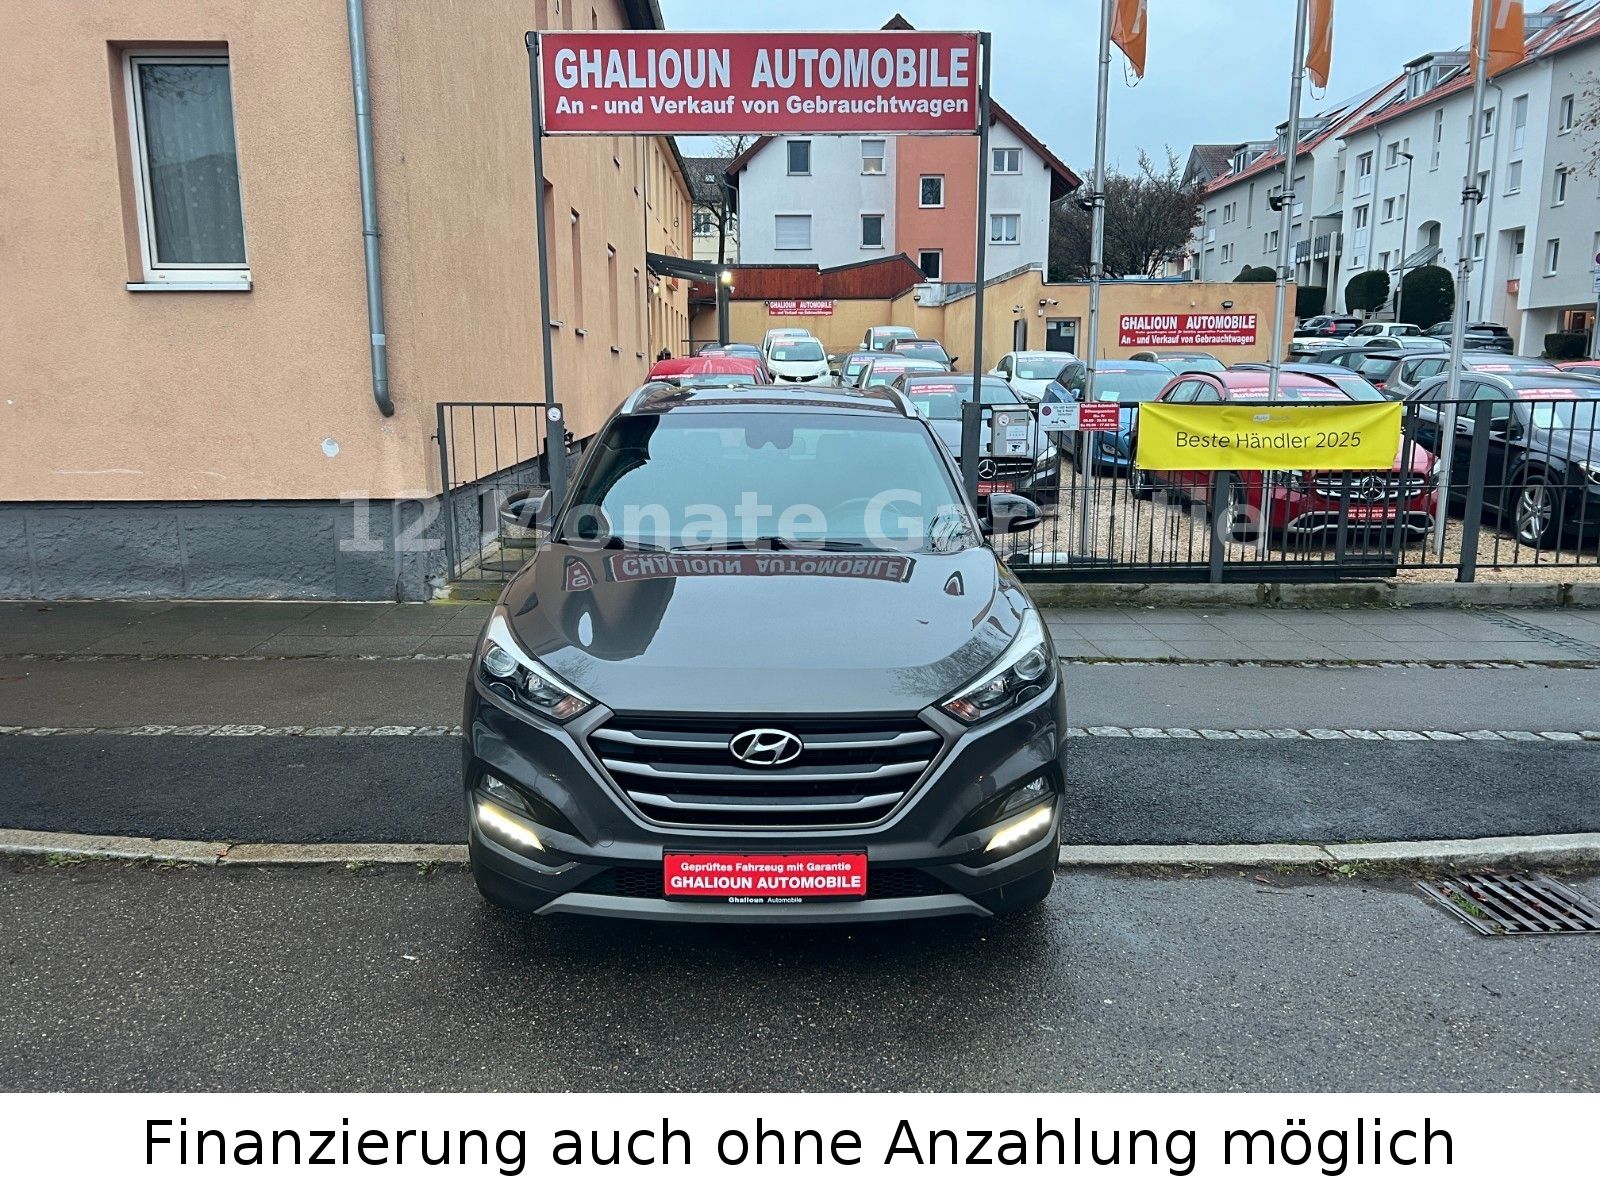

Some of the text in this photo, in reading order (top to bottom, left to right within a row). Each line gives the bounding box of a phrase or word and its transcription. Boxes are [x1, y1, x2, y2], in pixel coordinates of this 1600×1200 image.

[554, 47, 969, 89] GHALIOUN AUTOMOBILE
[556, 96, 583, 114] An
[605, 96, 643, 114] und
[650, 95, 735, 114] Verkauf
[742, 100, 780, 114] von
[786, 95, 969, 118] Gebrauchtwagen
[1121, 315, 1255, 330] GHALIOUN AUTOMOBILE
[1121, 335, 1131, 344] An
[1137, 335, 1150, 344] und
[1152, 334, 1179, 344] Verkauf
[1181, 336, 1194, 344] von
[1195, 334, 1255, 346] Gebrauchtwagen
[1176, 431, 1361, 449] Beste Händler 2025
[681, 862, 852, 873] Geprüftes Fahrzeug mit Garantie
[670, 875, 861, 889] GHALIOUN AUTOMOBILE
[728, 896, 803, 904] Ghalioun Automobile
